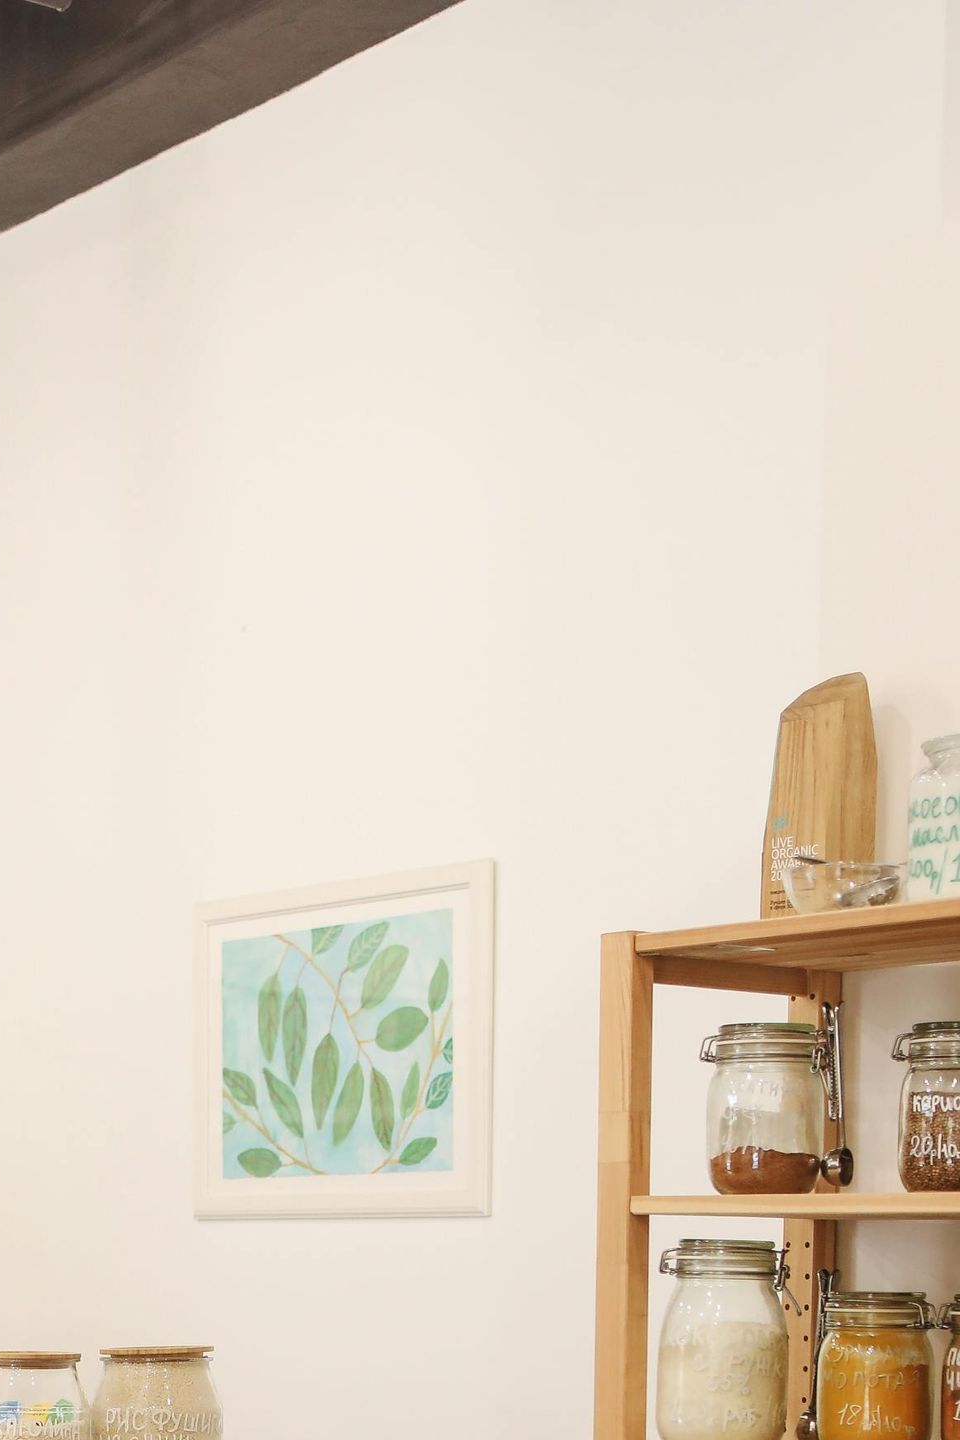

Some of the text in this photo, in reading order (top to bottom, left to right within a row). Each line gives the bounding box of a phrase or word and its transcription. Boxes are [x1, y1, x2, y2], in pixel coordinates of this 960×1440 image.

[771, 836, 793, 849] LIVE
[771, 844, 819, 861] ORGANIC
[105, 1407, 146, 1434] РИС
